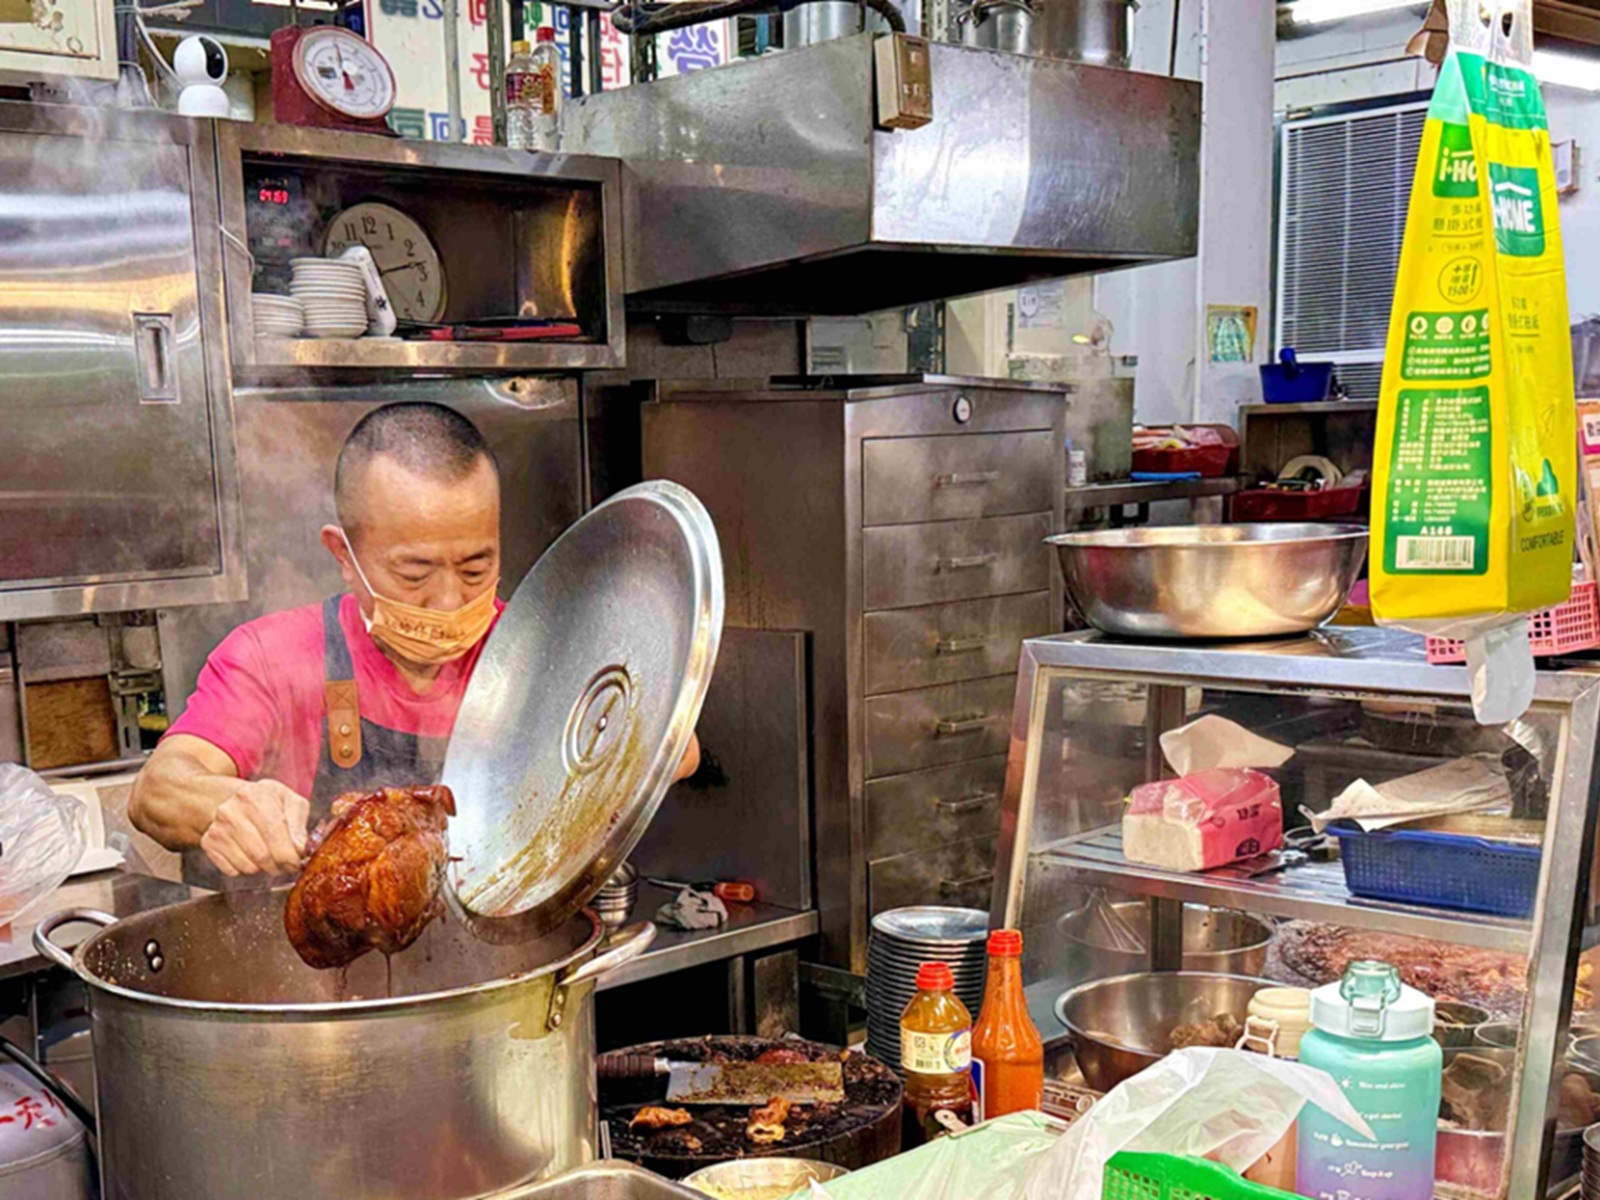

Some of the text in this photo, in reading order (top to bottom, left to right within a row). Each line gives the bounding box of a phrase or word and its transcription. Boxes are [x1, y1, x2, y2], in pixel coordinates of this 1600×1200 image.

[344, 223, 359, 241] 11
[361, 216, 377, 235] 12
[386, 223, 394, 241] 1
[404, 239, 416, 257] 2
[416, 291, 426, 308] 4
